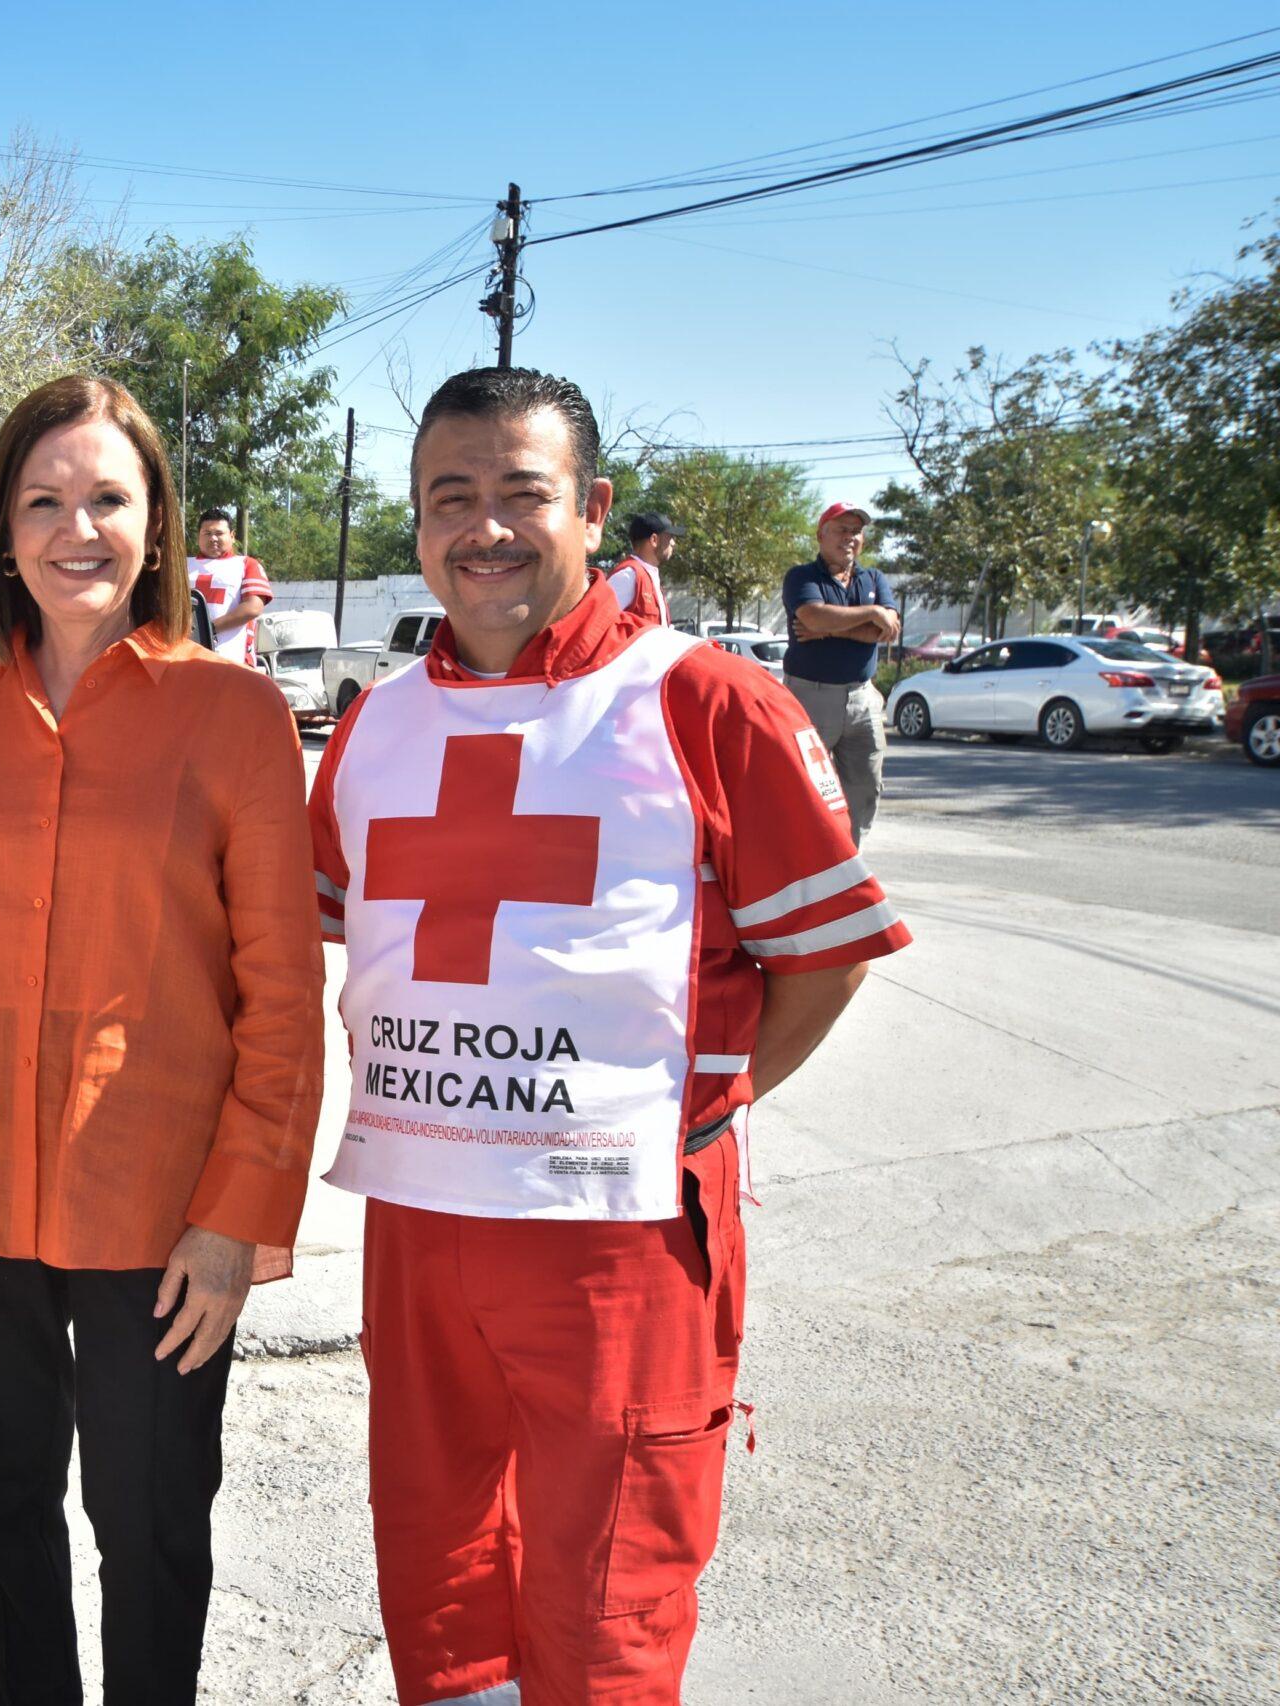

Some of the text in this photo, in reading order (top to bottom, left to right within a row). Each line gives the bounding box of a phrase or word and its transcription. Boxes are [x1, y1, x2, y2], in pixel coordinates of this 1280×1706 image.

[371, 1014, 580, 1062] CRUZ ROJA
[365, 1062, 574, 1114] MEXICANA
